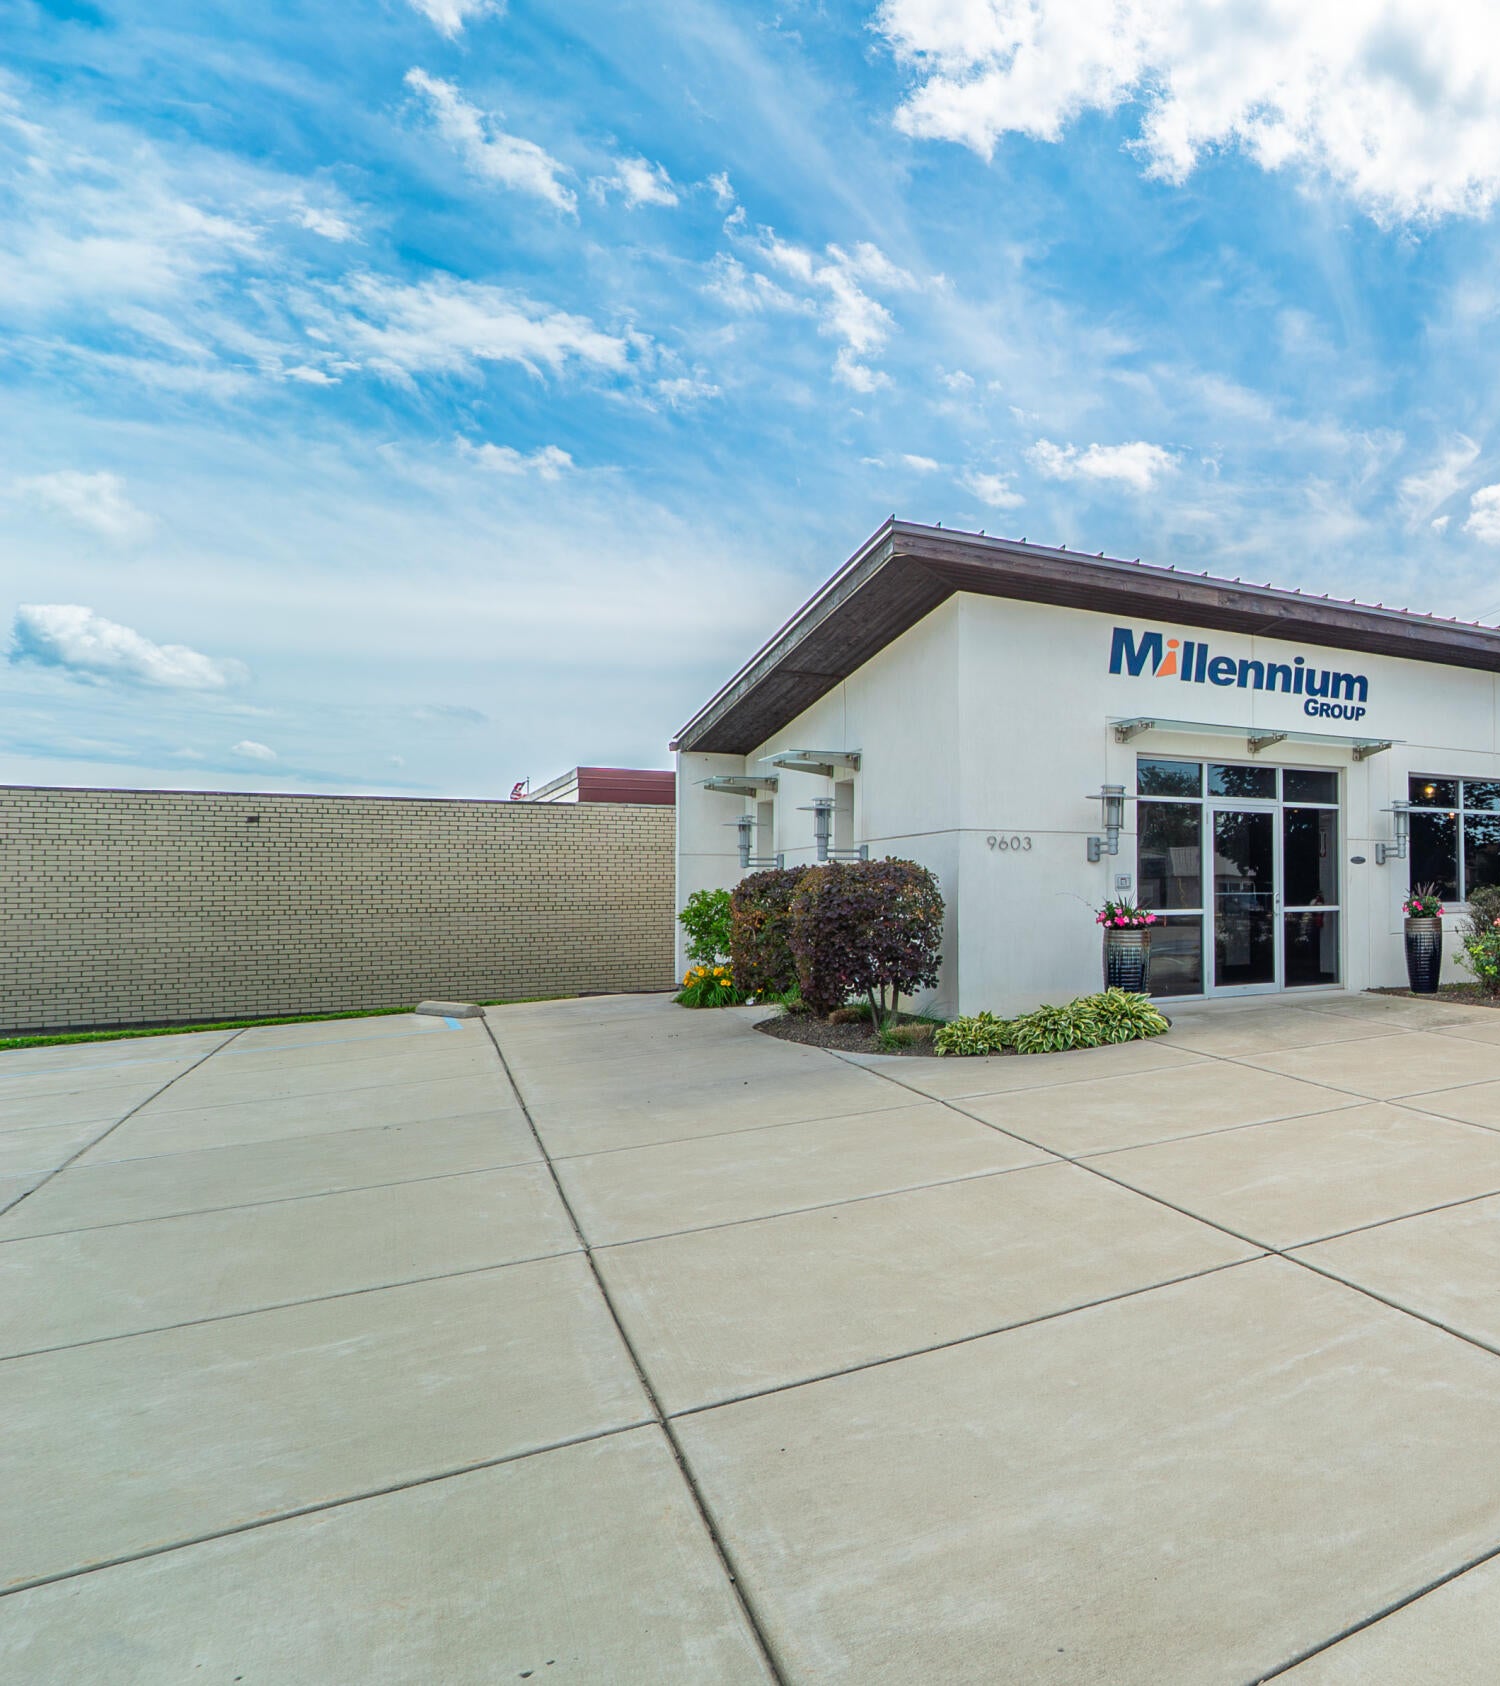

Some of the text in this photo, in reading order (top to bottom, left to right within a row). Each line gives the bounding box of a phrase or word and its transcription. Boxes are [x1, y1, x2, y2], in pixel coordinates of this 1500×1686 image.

[1108, 626, 1369, 703] Millennium
[1303, 698, 1366, 722] GROUP
[986, 835, 1032, 852] 9603
